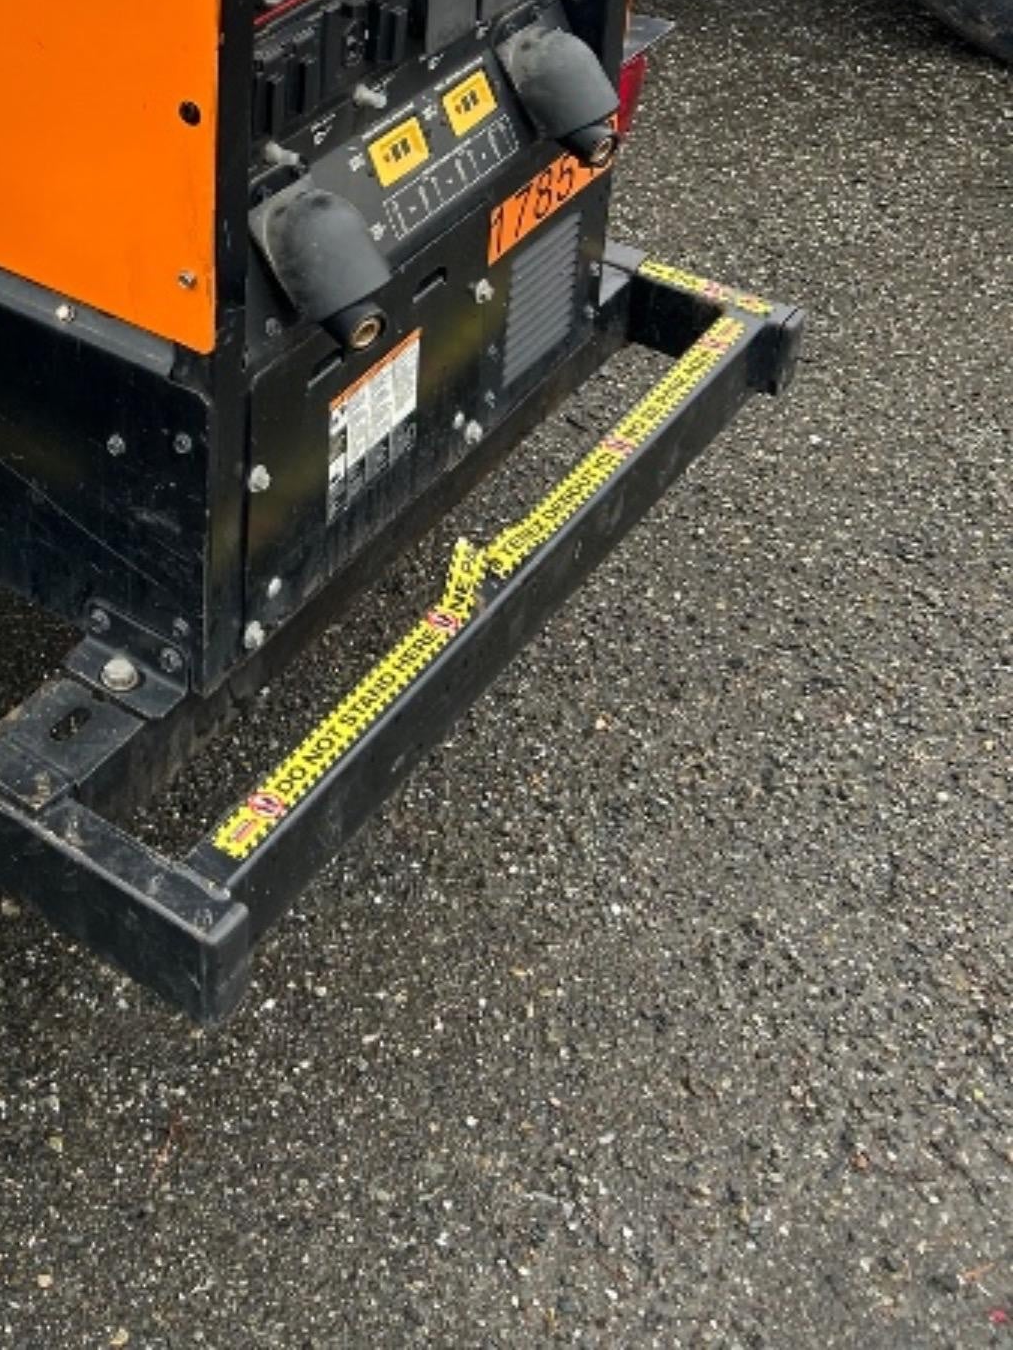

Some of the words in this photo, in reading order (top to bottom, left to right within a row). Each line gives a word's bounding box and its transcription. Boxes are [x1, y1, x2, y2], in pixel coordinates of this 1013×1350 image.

[276, 765, 307, 795] DO
[303, 726, 344, 765] NOT
[339, 671, 396, 727] STAND
[395, 629, 439, 673] HERE
